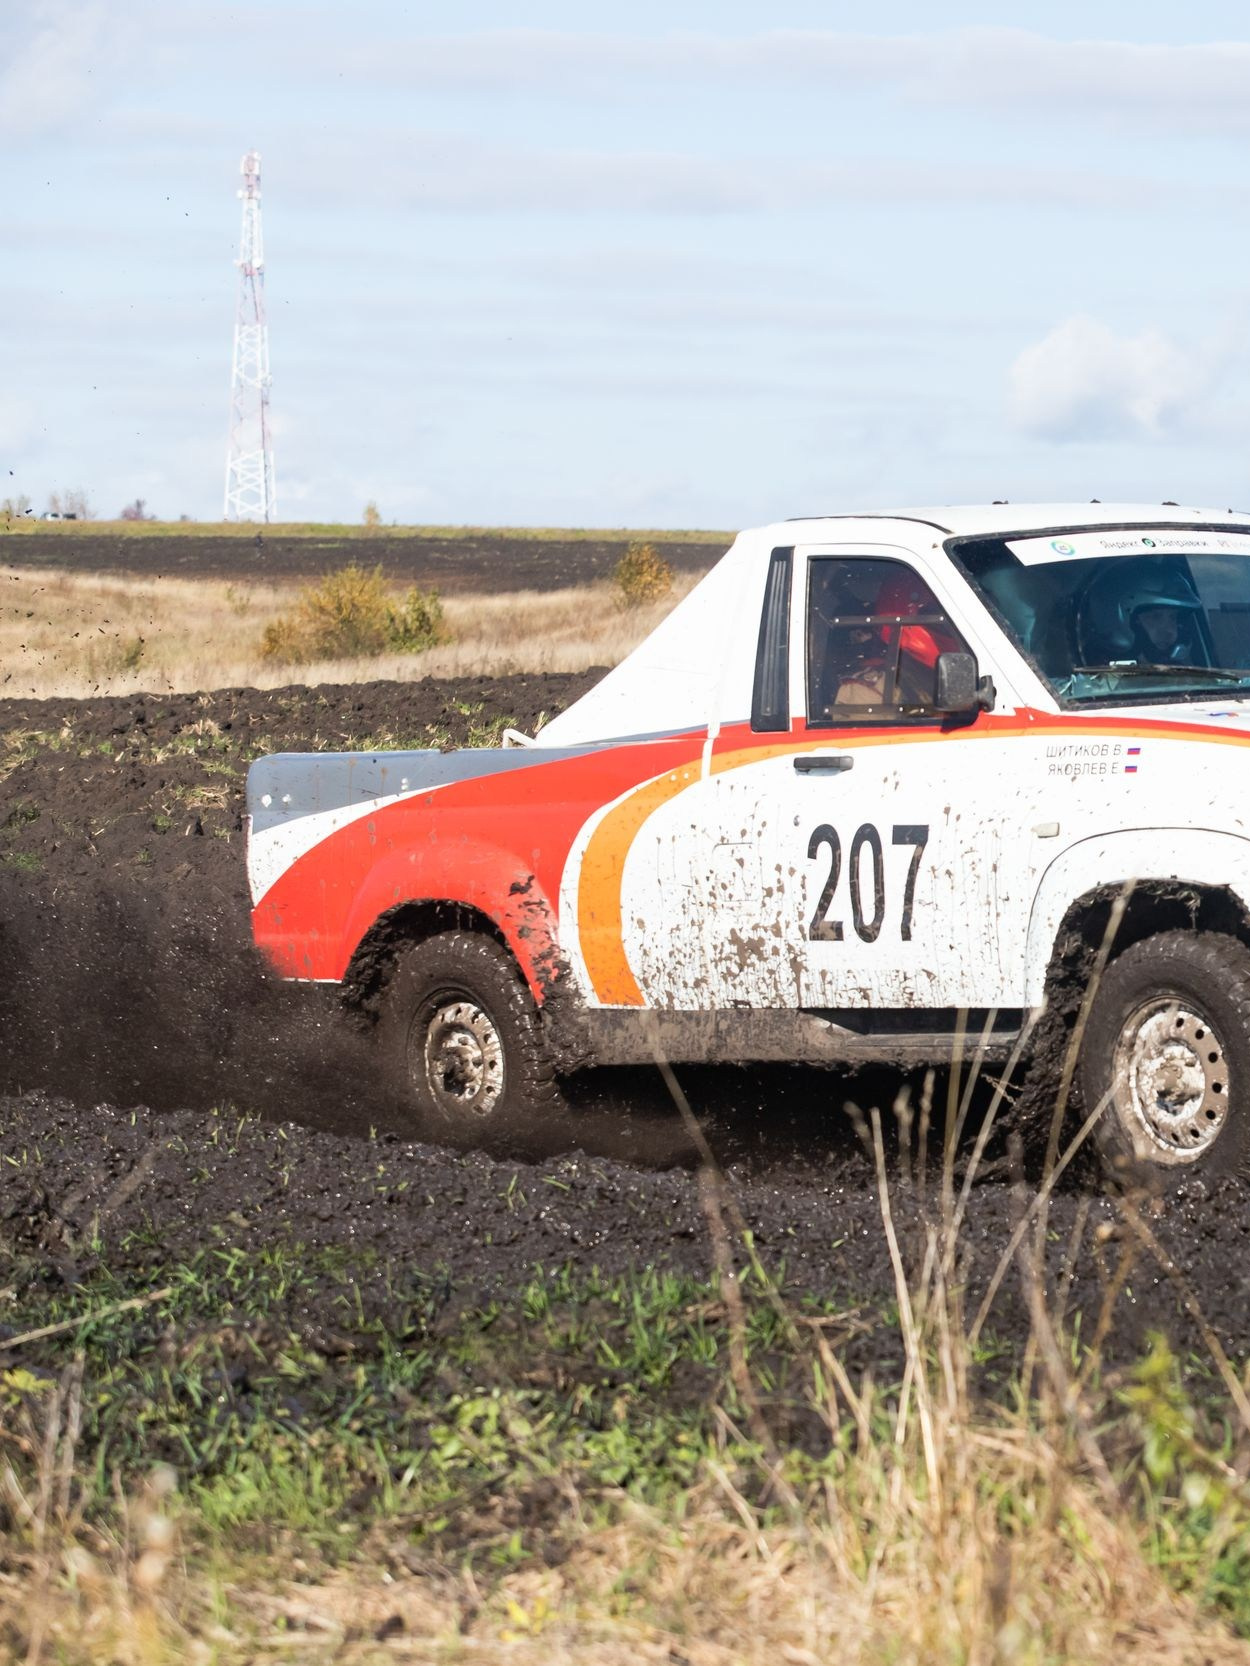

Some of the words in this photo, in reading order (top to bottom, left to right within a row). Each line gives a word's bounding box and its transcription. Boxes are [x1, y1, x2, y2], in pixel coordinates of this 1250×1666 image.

[1046, 744, 1109, 758] ШИТИКОВ
[1113, 744, 1122, 756] В
[1048, 762, 1107, 776] ЯКОВЛЕВ
[1111, 762, 1119, 774] Е
[807, 822, 929, 944] 207
